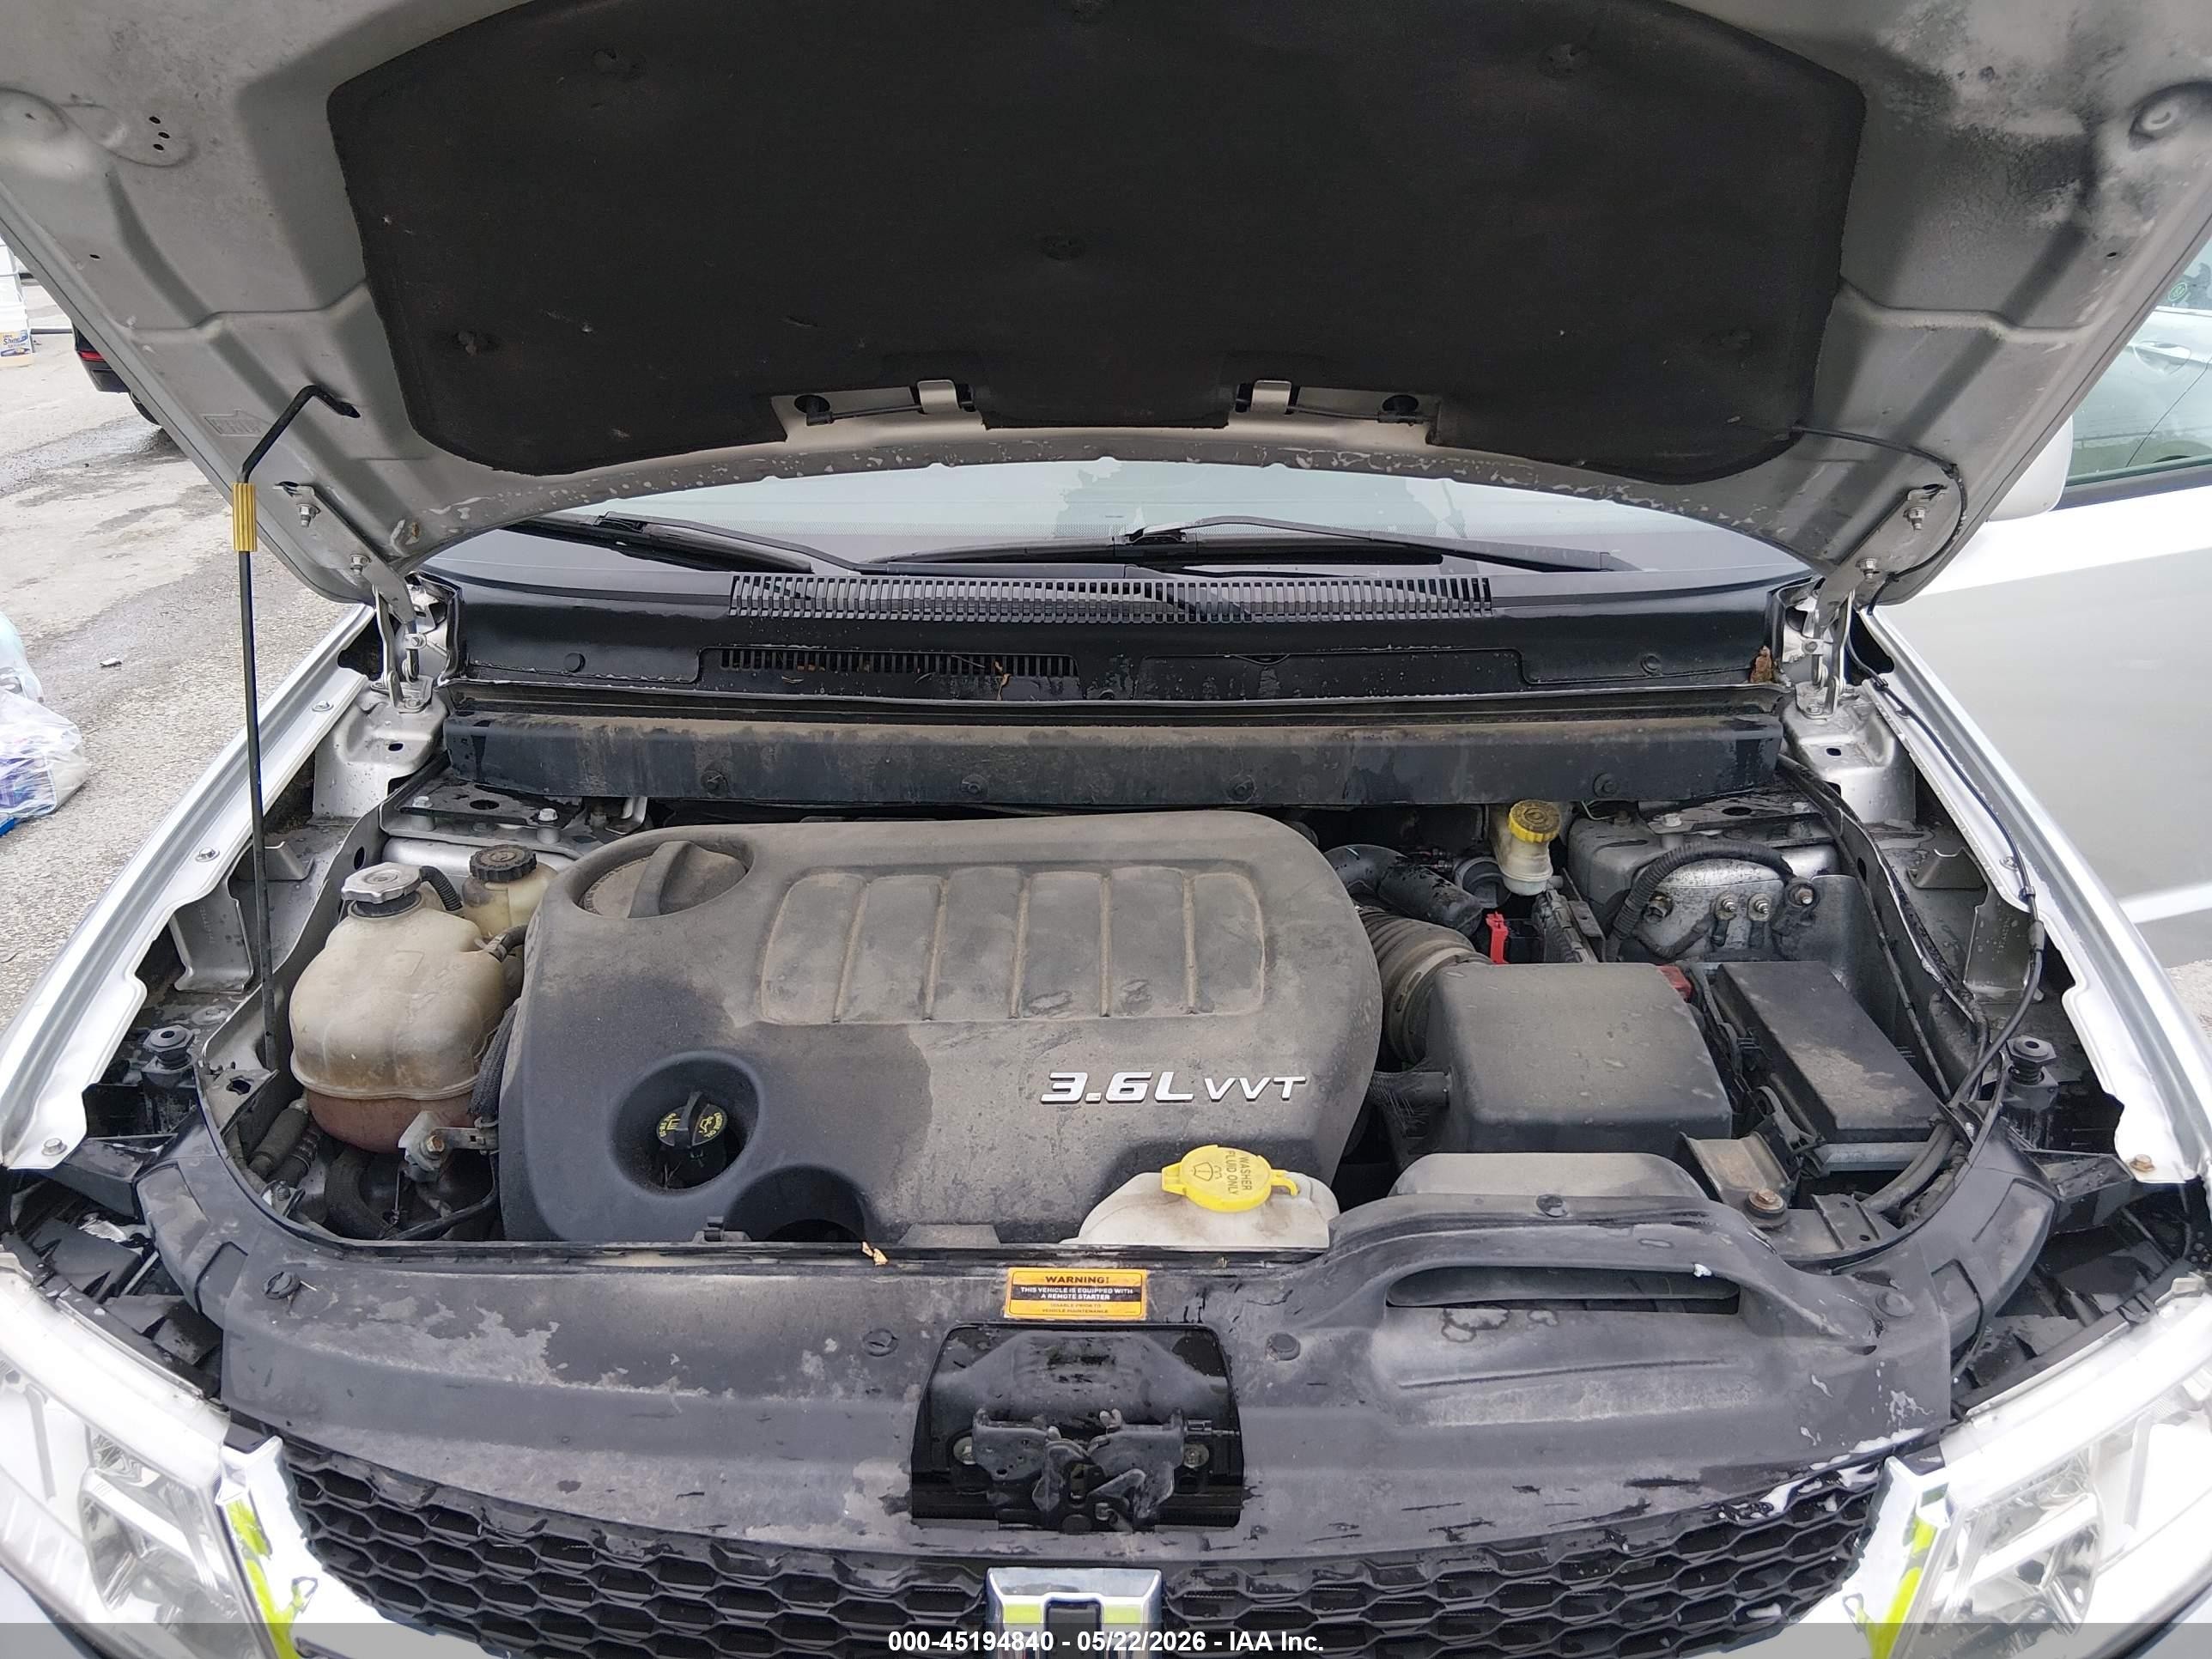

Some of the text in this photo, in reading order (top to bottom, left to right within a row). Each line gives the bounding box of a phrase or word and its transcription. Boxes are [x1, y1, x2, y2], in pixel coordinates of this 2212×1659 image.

[1040, 1071, 1307, 1104] 3.6L VVT
[1225, 1151, 1239, 1195] FLUID ONLY
[1239, 1156, 1252, 1191] WASHER
